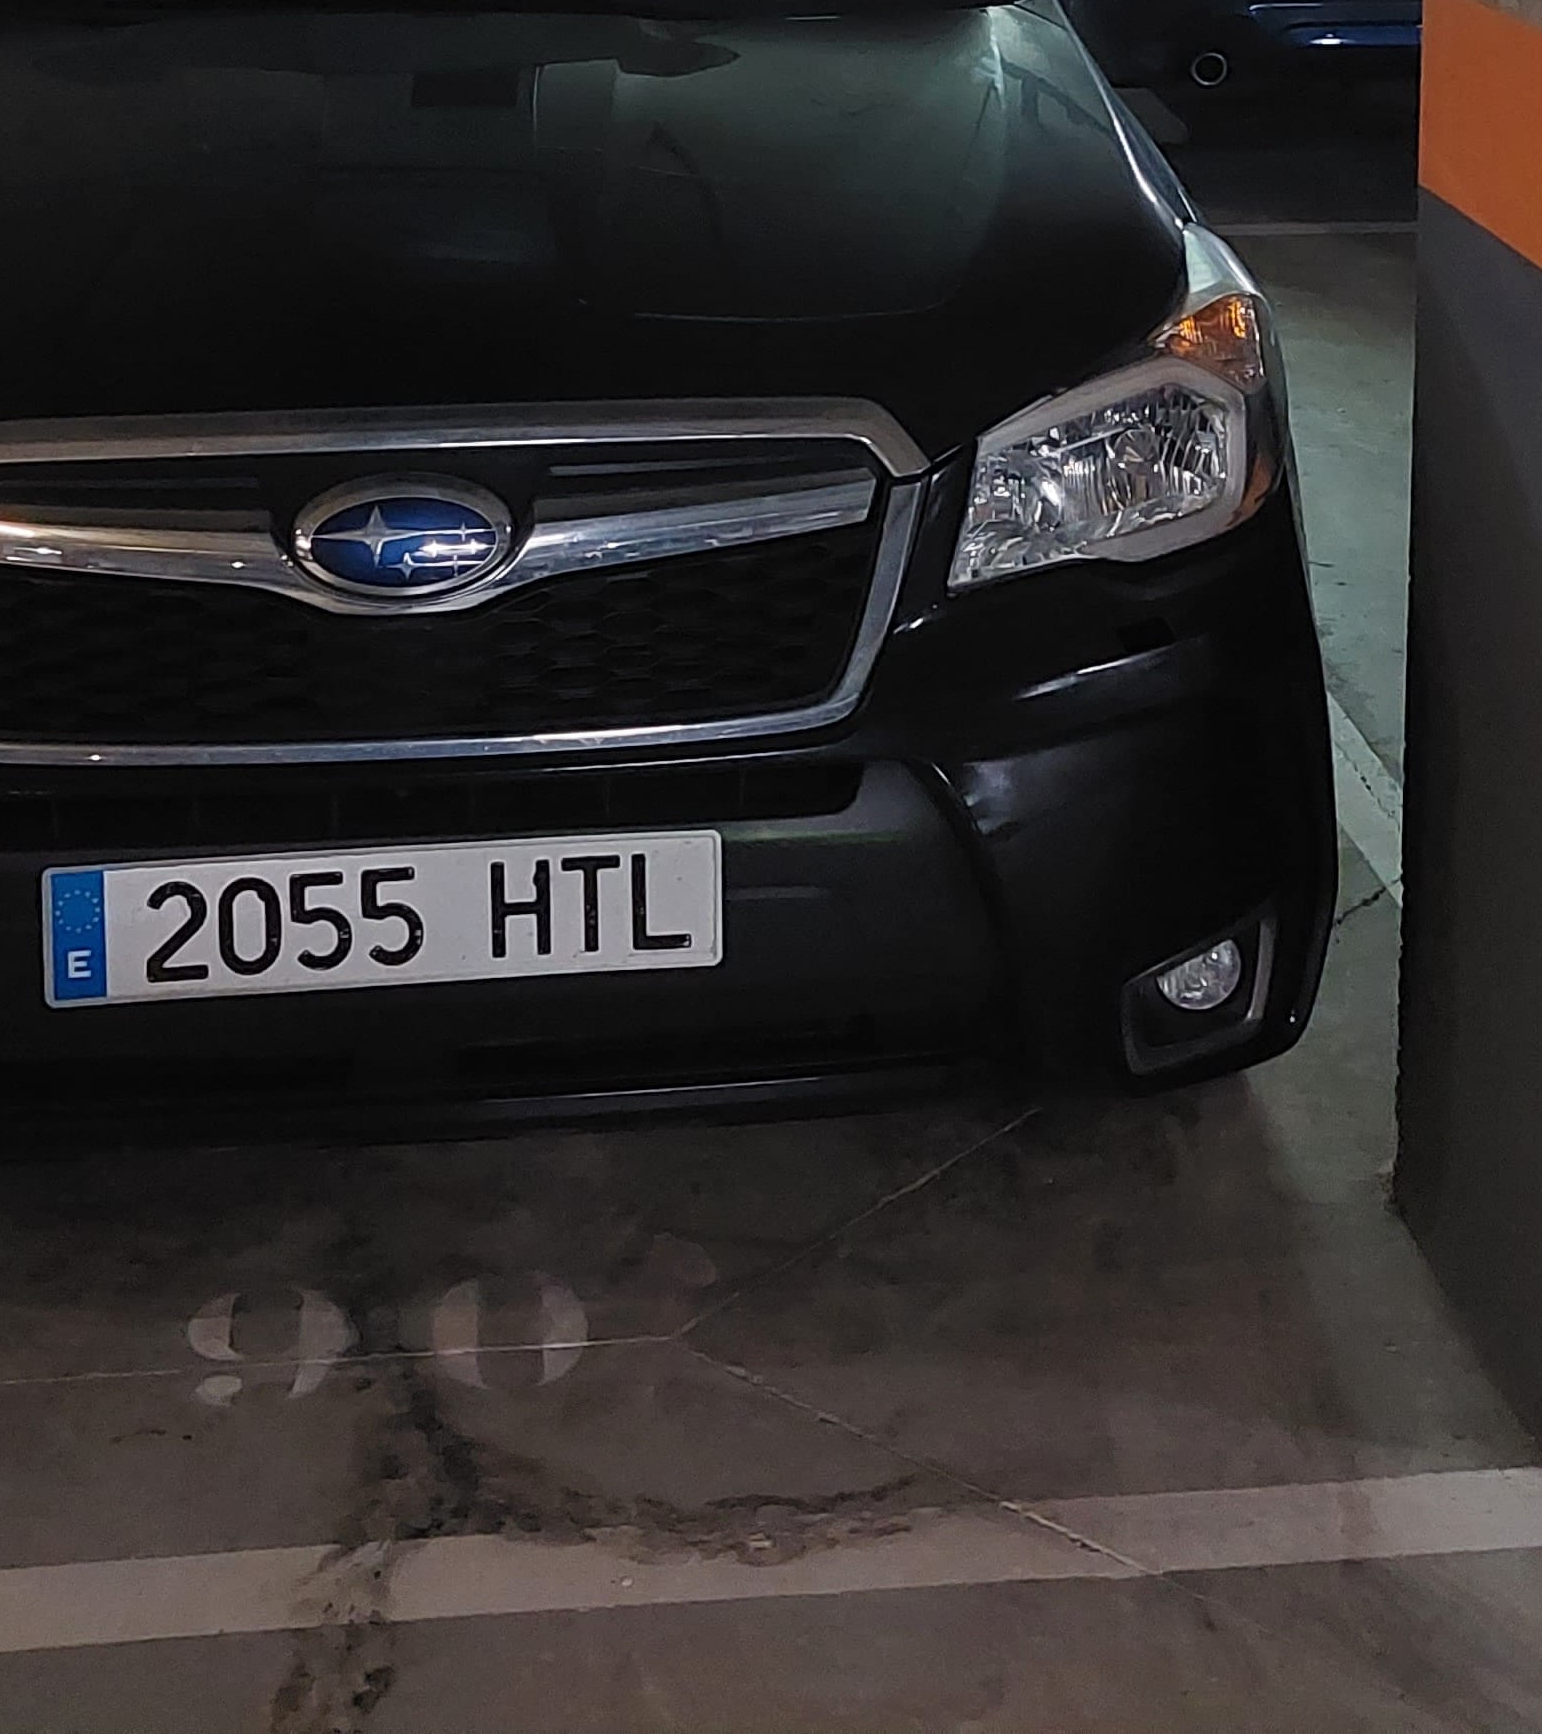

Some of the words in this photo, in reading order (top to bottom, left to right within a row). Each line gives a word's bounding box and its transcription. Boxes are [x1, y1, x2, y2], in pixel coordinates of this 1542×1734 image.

[66, 949, 92, 979] E
[145, 866, 425, 983] 2055
[488, 852, 692, 958] HTL
[187, 1271, 589, 1399] 90
